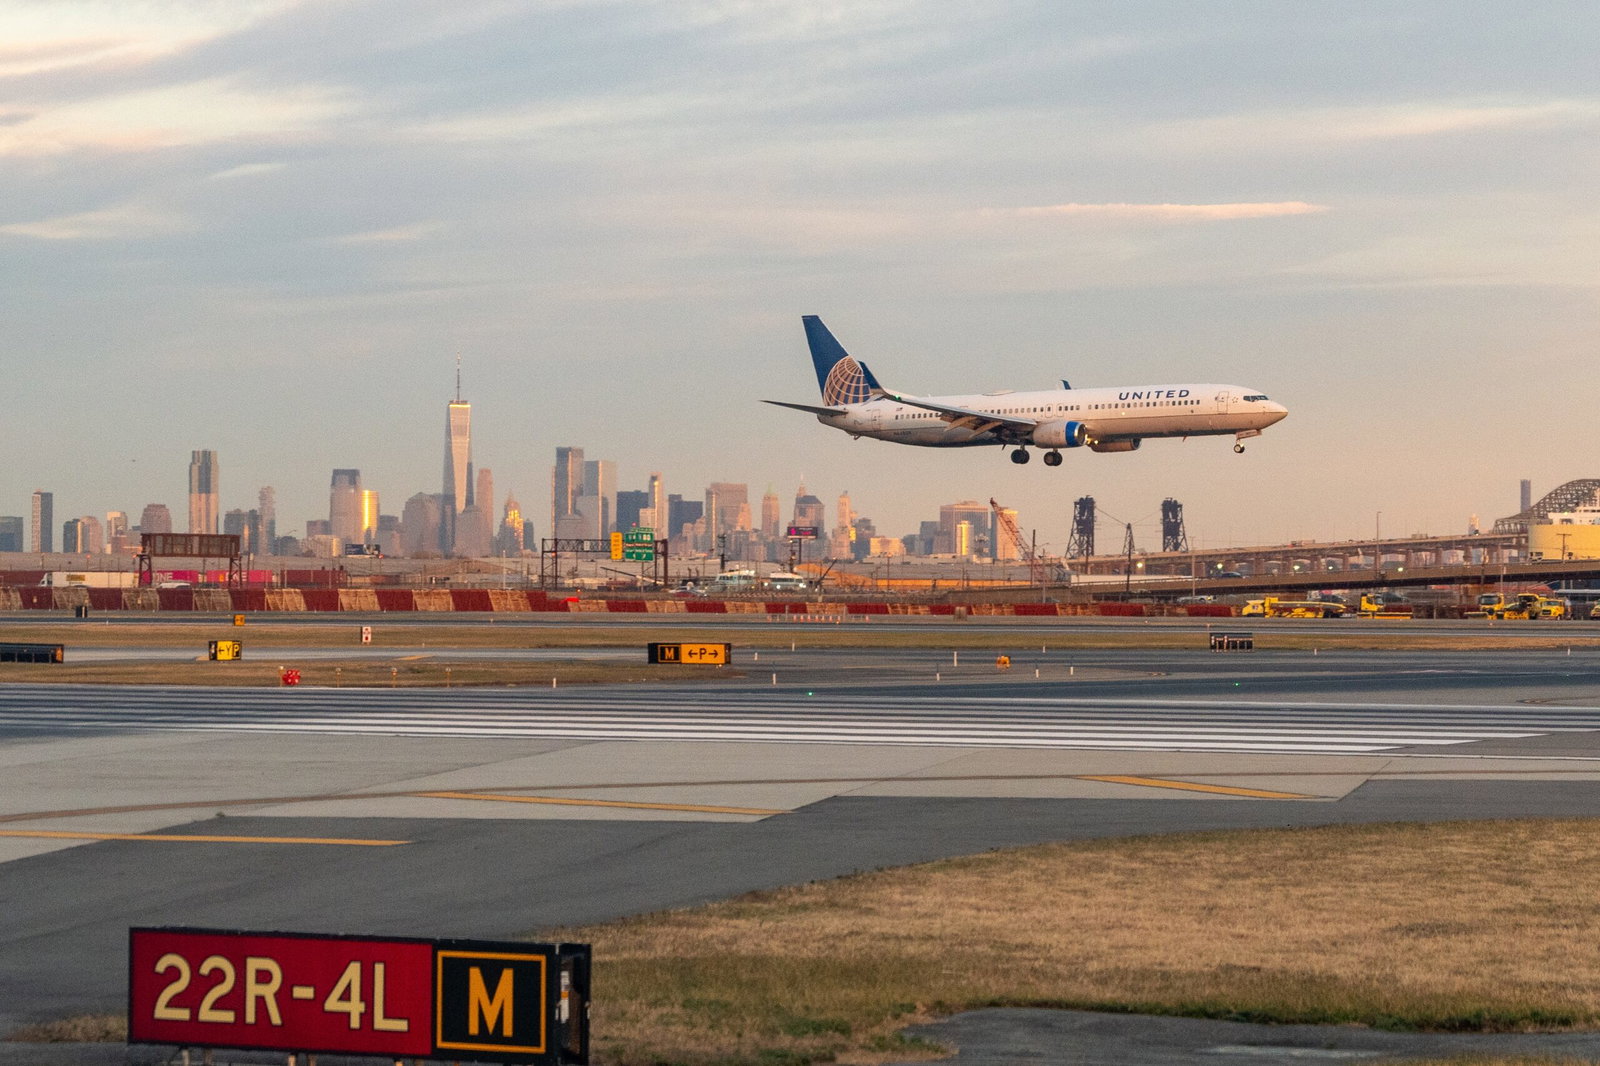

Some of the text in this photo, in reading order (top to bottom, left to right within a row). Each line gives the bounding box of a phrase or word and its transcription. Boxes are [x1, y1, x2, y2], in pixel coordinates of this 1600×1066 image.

[1119, 389, 1190, 401] UNITED
[226, 644, 232, 656] Y
[233, 644, 240, 657] P
[664, 647, 675, 660] M
[699, 648, 707, 660] P
[153, 952, 409, 1033] 22R-4L
[468, 965, 514, 1038] M
